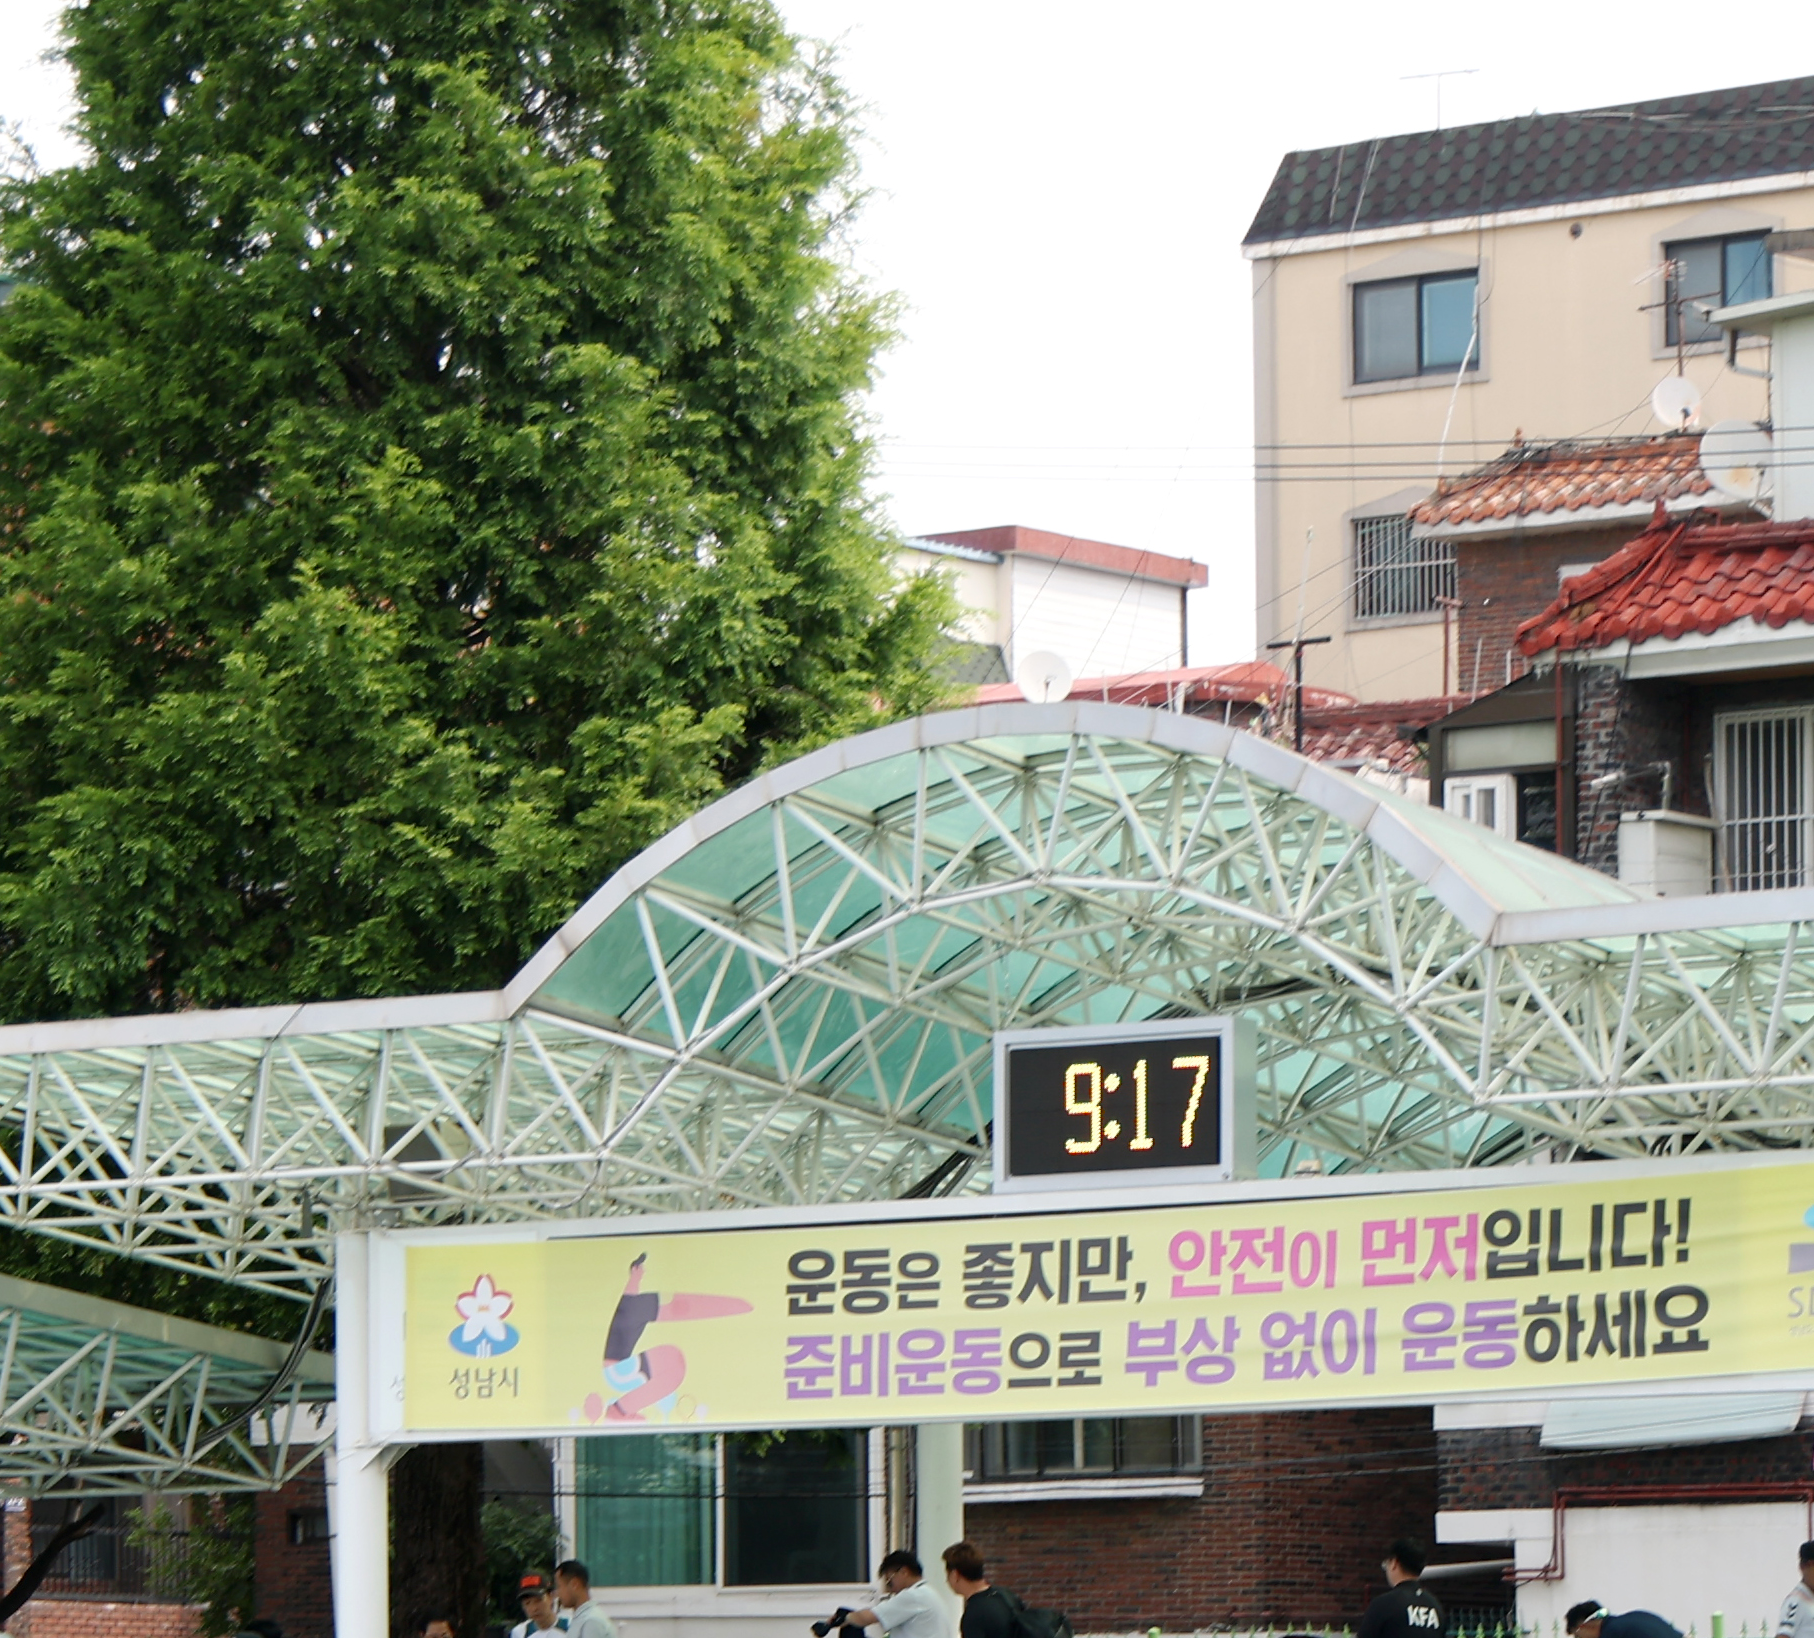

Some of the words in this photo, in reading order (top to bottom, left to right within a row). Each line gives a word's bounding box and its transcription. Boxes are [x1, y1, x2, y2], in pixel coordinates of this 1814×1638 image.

[1065, 1055, 1210, 1154] 9:17
[786, 1248, 942, 1316] 운동은
[962, 1235, 1147, 1309] 좋지만,
[1168, 1226, 1338, 1299] 안전이
[1360, 1197, 1692, 1288] 먼저입니다!
[449, 1366, 520, 1399] 성남시
[784, 1327, 1102, 1400] 준비운동으로
[1124, 1315, 1241, 1388] 부상
[1259, 1307, 1378, 1381] 없이
[1400, 1284, 1710, 1373] 운동하세요
[1407, 1605, 1440, 1630] KFA
